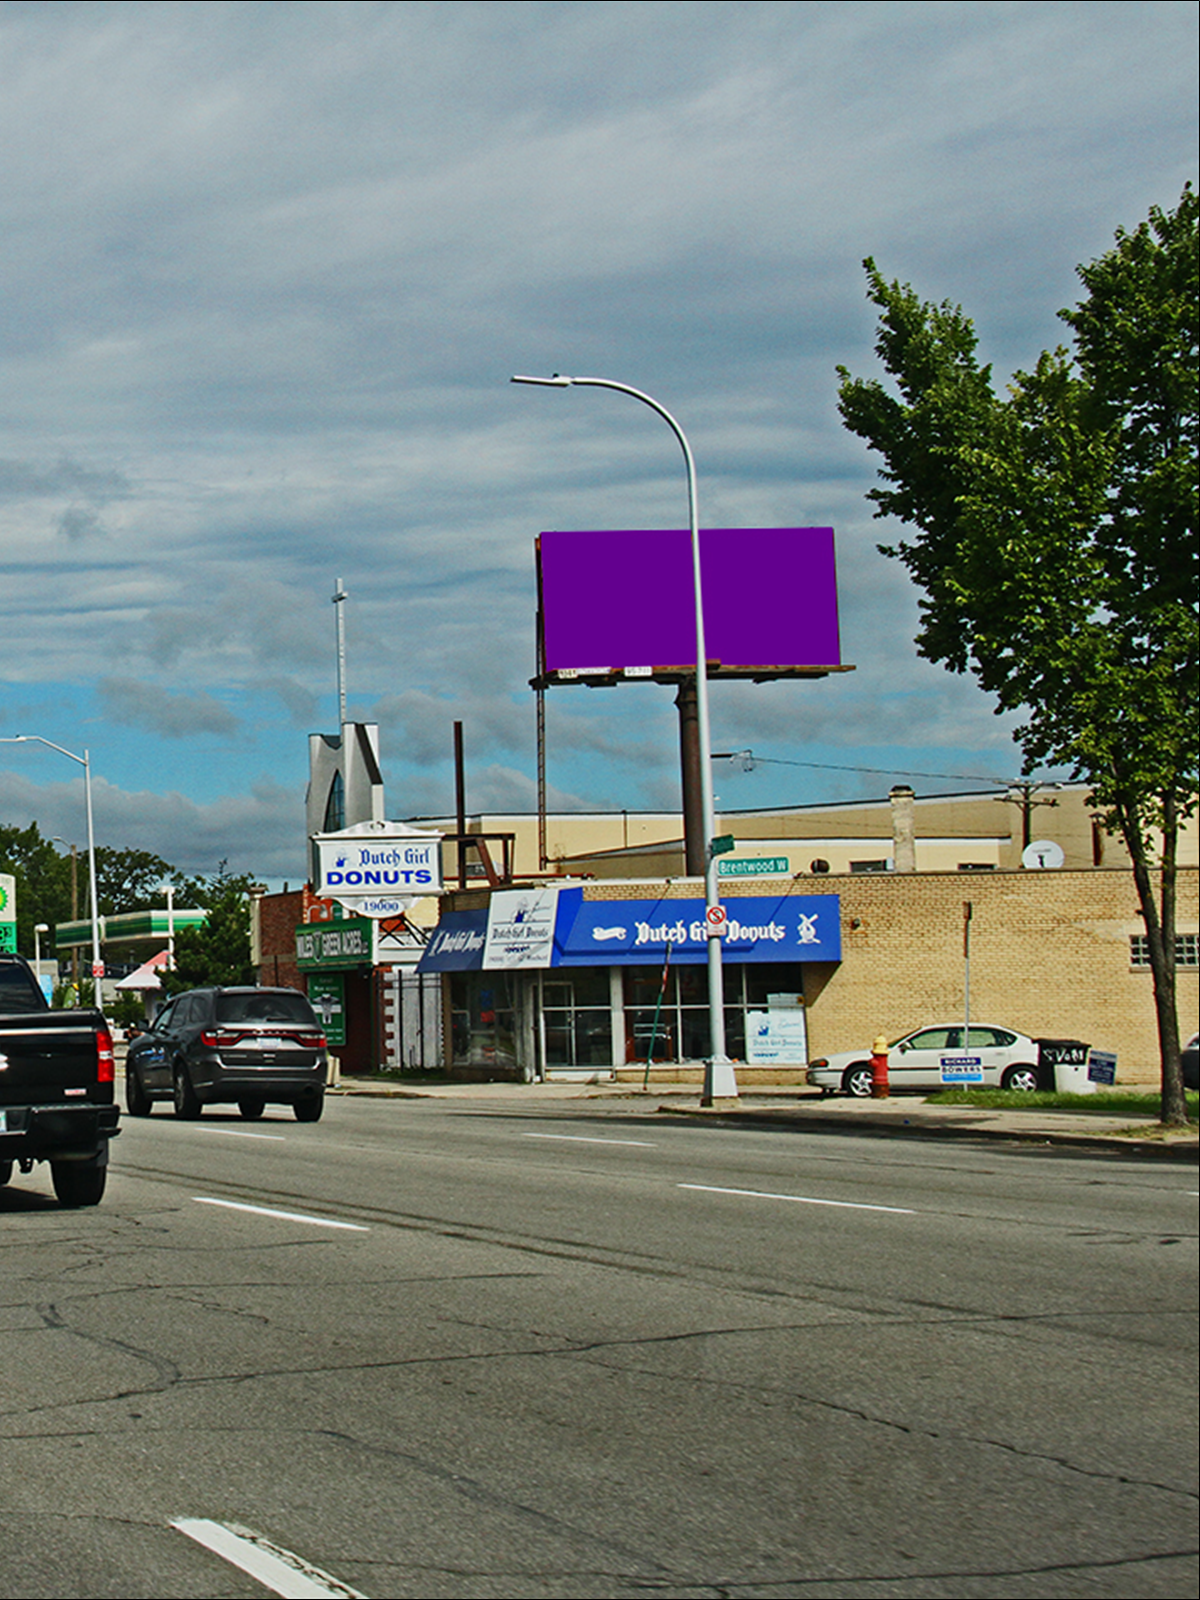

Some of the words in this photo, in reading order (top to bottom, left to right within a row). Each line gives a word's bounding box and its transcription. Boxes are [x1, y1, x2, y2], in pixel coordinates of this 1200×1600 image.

[358, 847, 401, 868] Dutch
[404, 847, 431, 865] Girl
[719, 859, 775, 874] Brentwood
[776, 859, 787, 871] W
[326, 869, 433, 886] DONUTS
[363, 901, 400, 912] 19000
[635, 920, 687, 946] Dutch
[725, 919, 787, 945] Donuts
